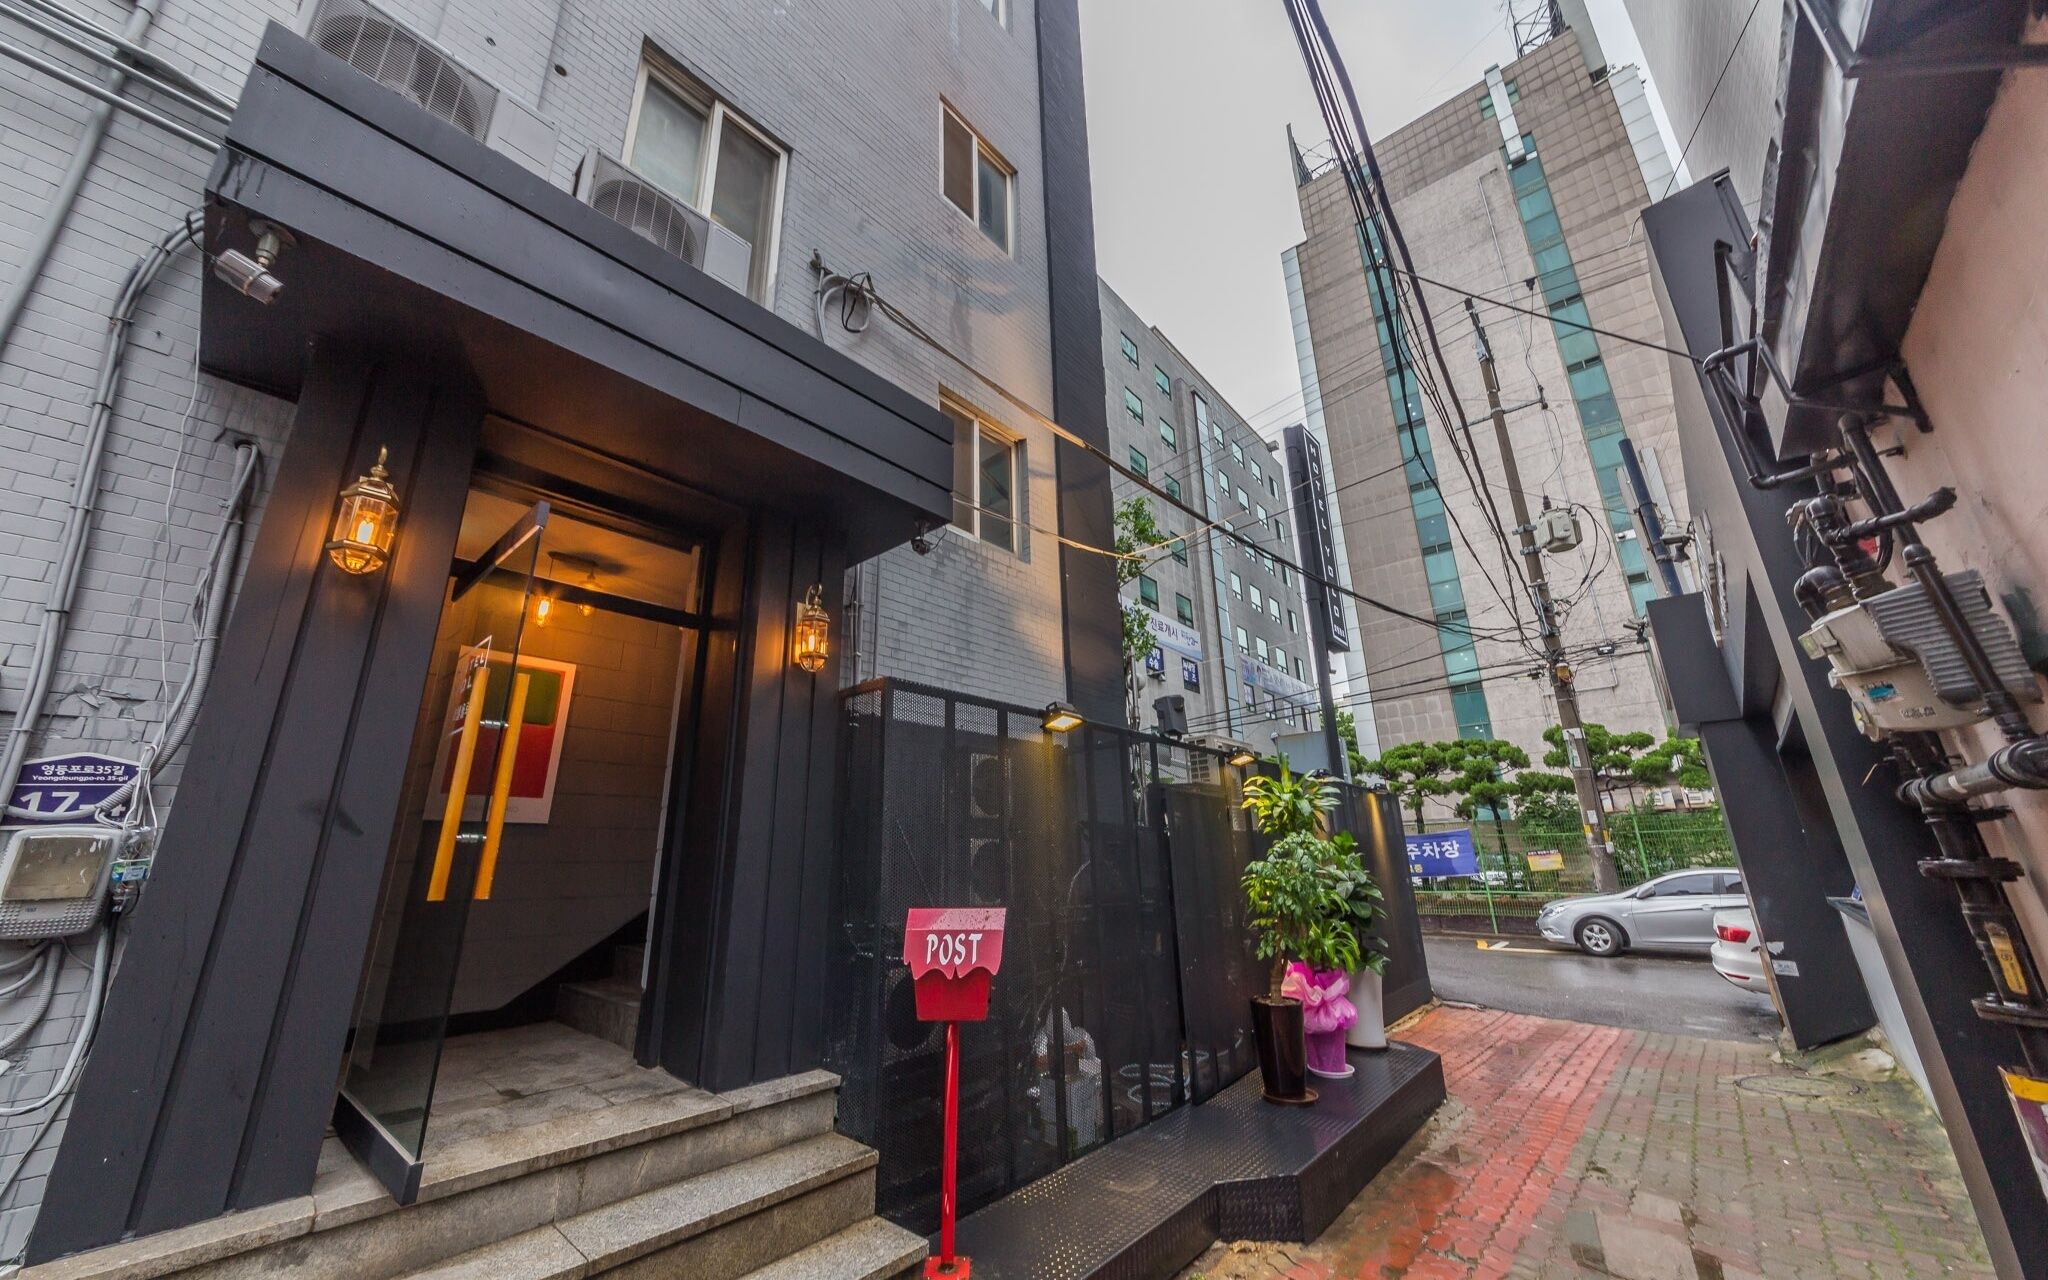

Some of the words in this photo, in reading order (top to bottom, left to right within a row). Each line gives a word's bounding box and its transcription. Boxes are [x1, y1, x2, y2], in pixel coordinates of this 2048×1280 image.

[1309, 443, 1327, 530] HOTEL
[41, 764, 125, 776] 영등포로35길
[1406, 840, 1460, 861] 주차장
[926, 933, 983, 966] POST
